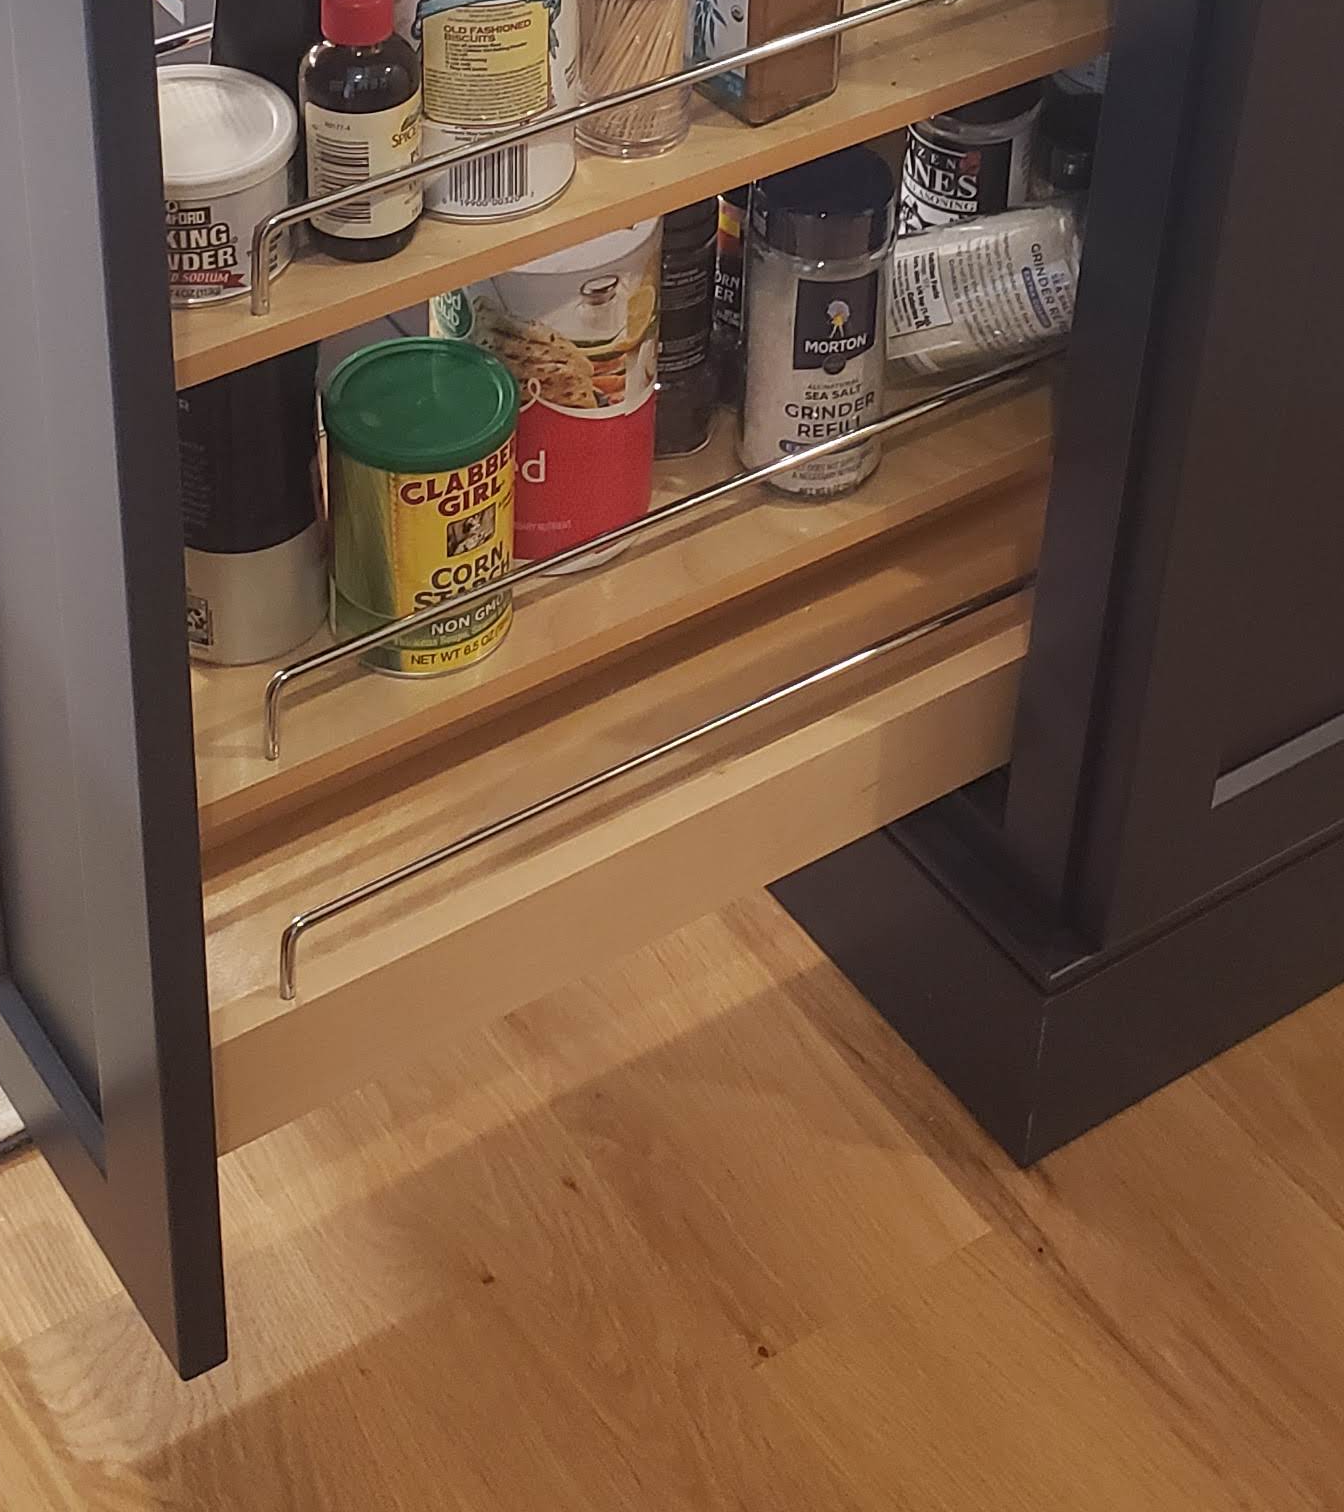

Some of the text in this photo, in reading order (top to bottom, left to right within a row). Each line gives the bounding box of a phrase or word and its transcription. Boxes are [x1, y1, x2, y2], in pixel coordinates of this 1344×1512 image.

[443, 19, 532, 35] OLD FASHIONED
[443, 33, 497, 43] BISCUITS
[183, 272, 230, 284] SODIUM
[1031, 243, 1055, 306] GRINDER
[805, 334, 867, 354] MORTON
[804, 384, 862, 401] SEA SALT
[785, 391, 876, 420] GRINDER
[400, 441, 513, 507] CLABBE
[438, 474, 503, 516] GIRL
[431, 540, 504, 590] CORN
[431, 615, 471, 636] NON
[475, 592, 504, 621] GMO
[411, 653, 436, 665] NET
[440, 648, 461, 663] WT
